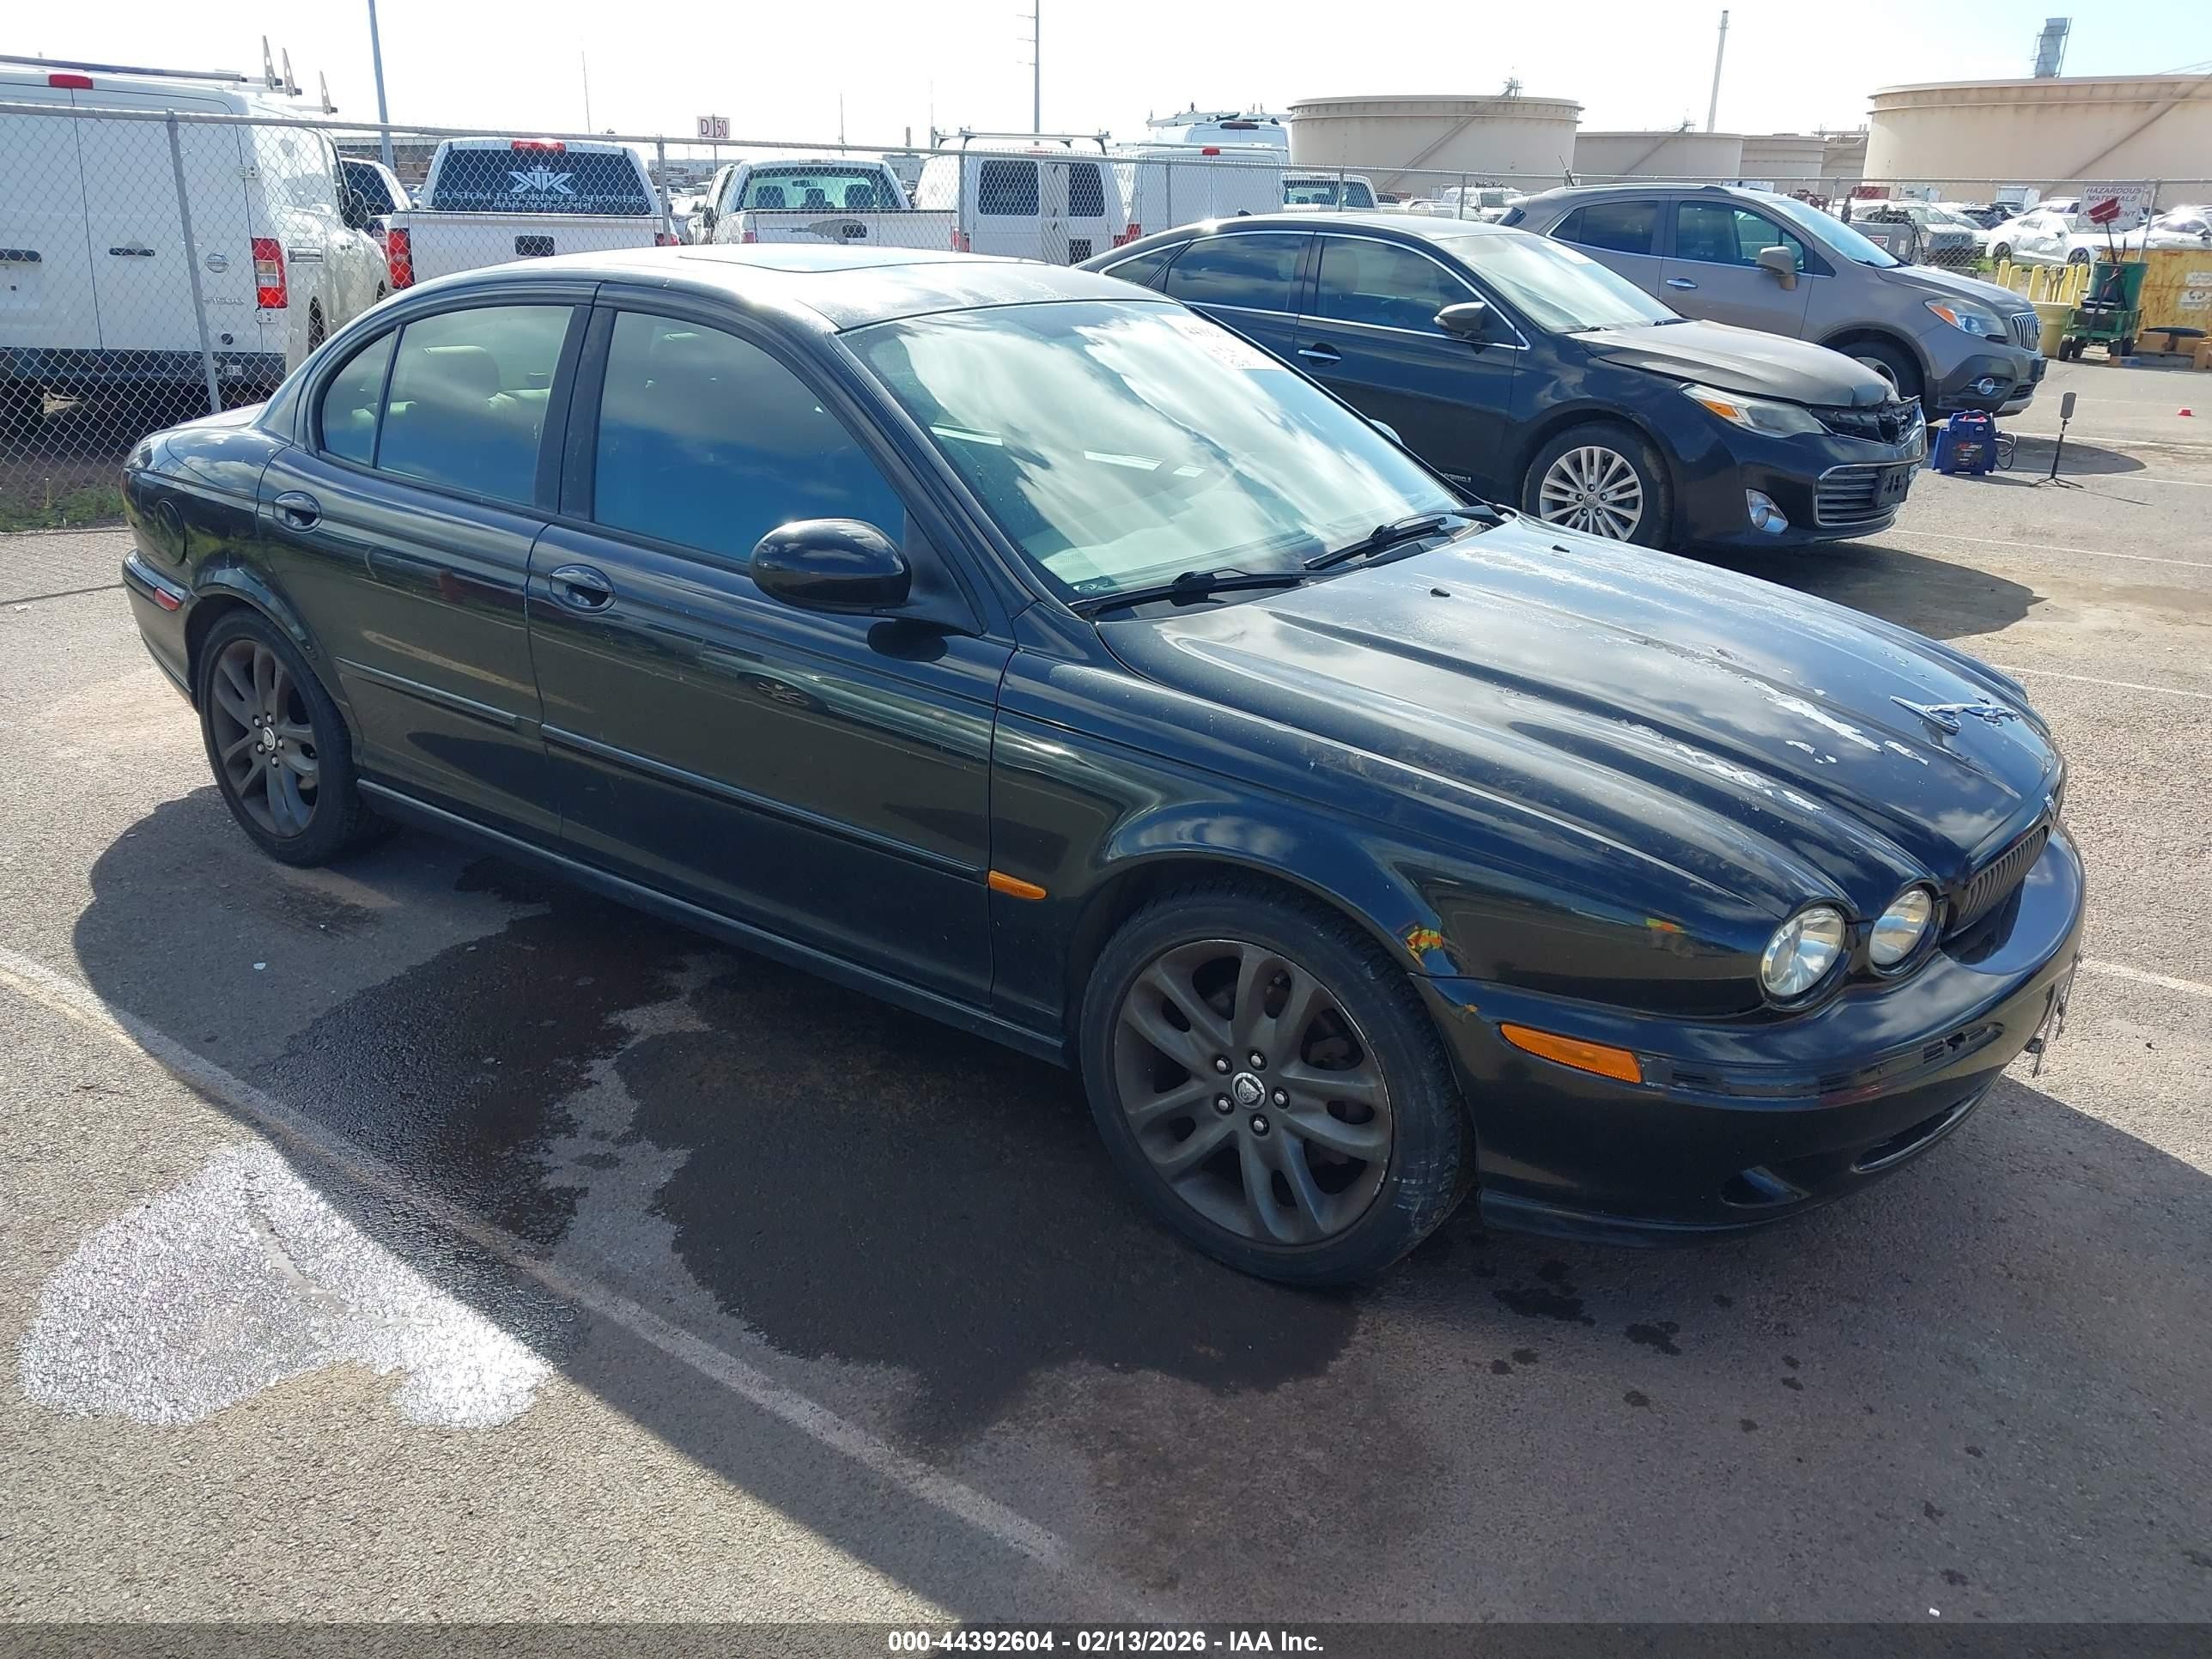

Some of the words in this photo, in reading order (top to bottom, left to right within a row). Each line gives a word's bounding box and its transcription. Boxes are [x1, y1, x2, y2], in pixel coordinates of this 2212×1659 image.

[700, 118, 709, 135] D
[434, 191, 491, 200] CUSTOM
[495, 191, 563, 201] FLOORING
[583, 194, 647, 204] SHOWERS
